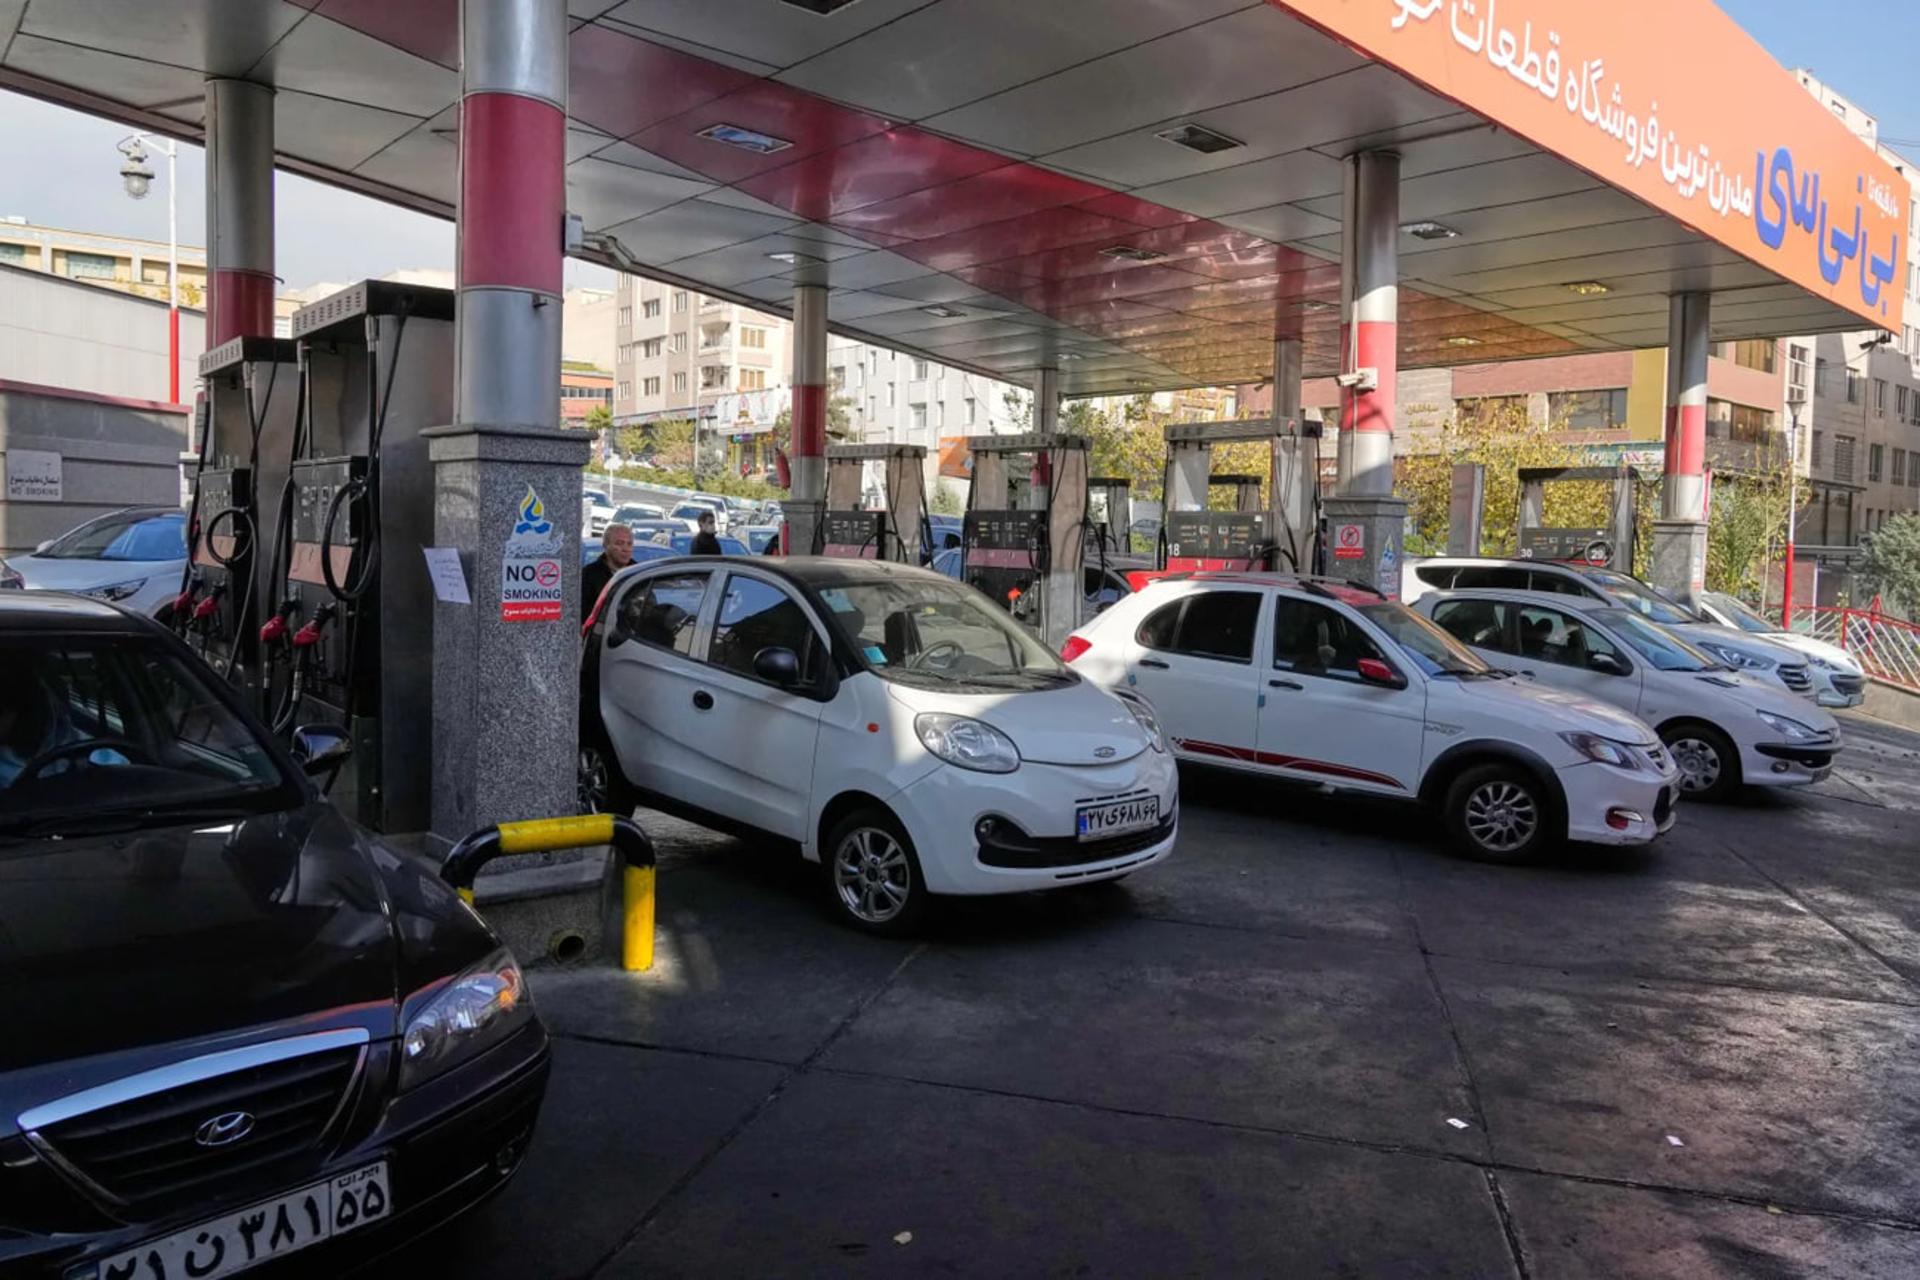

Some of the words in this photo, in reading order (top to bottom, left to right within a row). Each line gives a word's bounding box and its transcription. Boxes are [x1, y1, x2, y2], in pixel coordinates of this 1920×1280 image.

[1451, 0, 1560, 99] قطعات
[1564, 58, 1659, 168] فروشگاه
[1708, 161, 1752, 217] مدرن
[1168, 542, 1181, 557] 18
[1520, 548, 1533, 558] 30
[506, 565, 536, 582] NO
[504, 588, 561, 600] SMOKING
[335, 1179, 386, 1229] ۵۵
